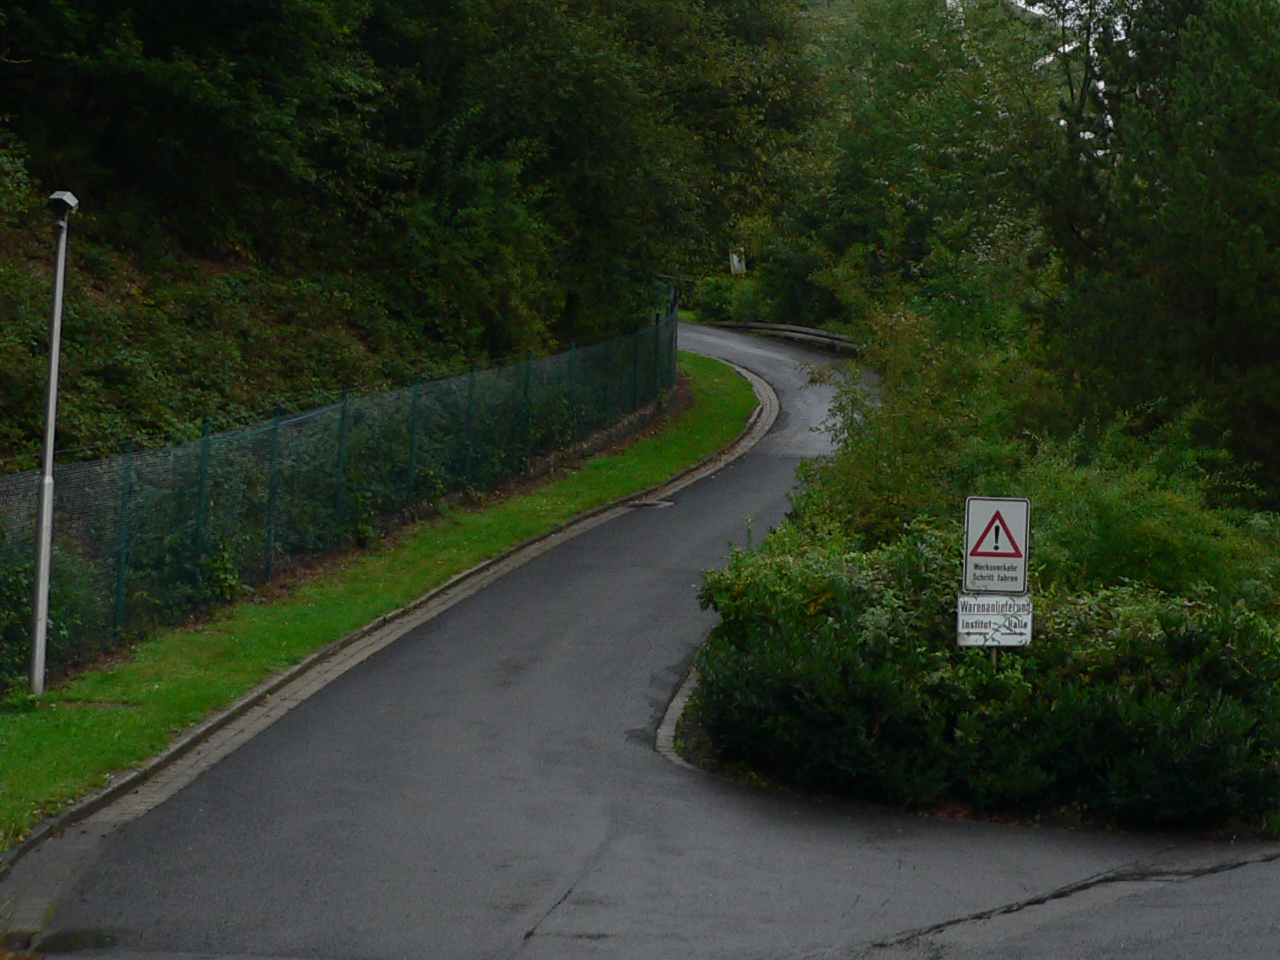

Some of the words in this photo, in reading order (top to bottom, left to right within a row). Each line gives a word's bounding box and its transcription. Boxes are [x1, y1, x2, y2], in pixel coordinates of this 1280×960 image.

[973, 572, 995, 581] Schritt
[997, 573, 1018, 581] fahren
[961, 600, 1031, 615] Warenanlieferung
[962, 619, 991, 629] Institut
[1008, 619, 1028, 629] Halle
